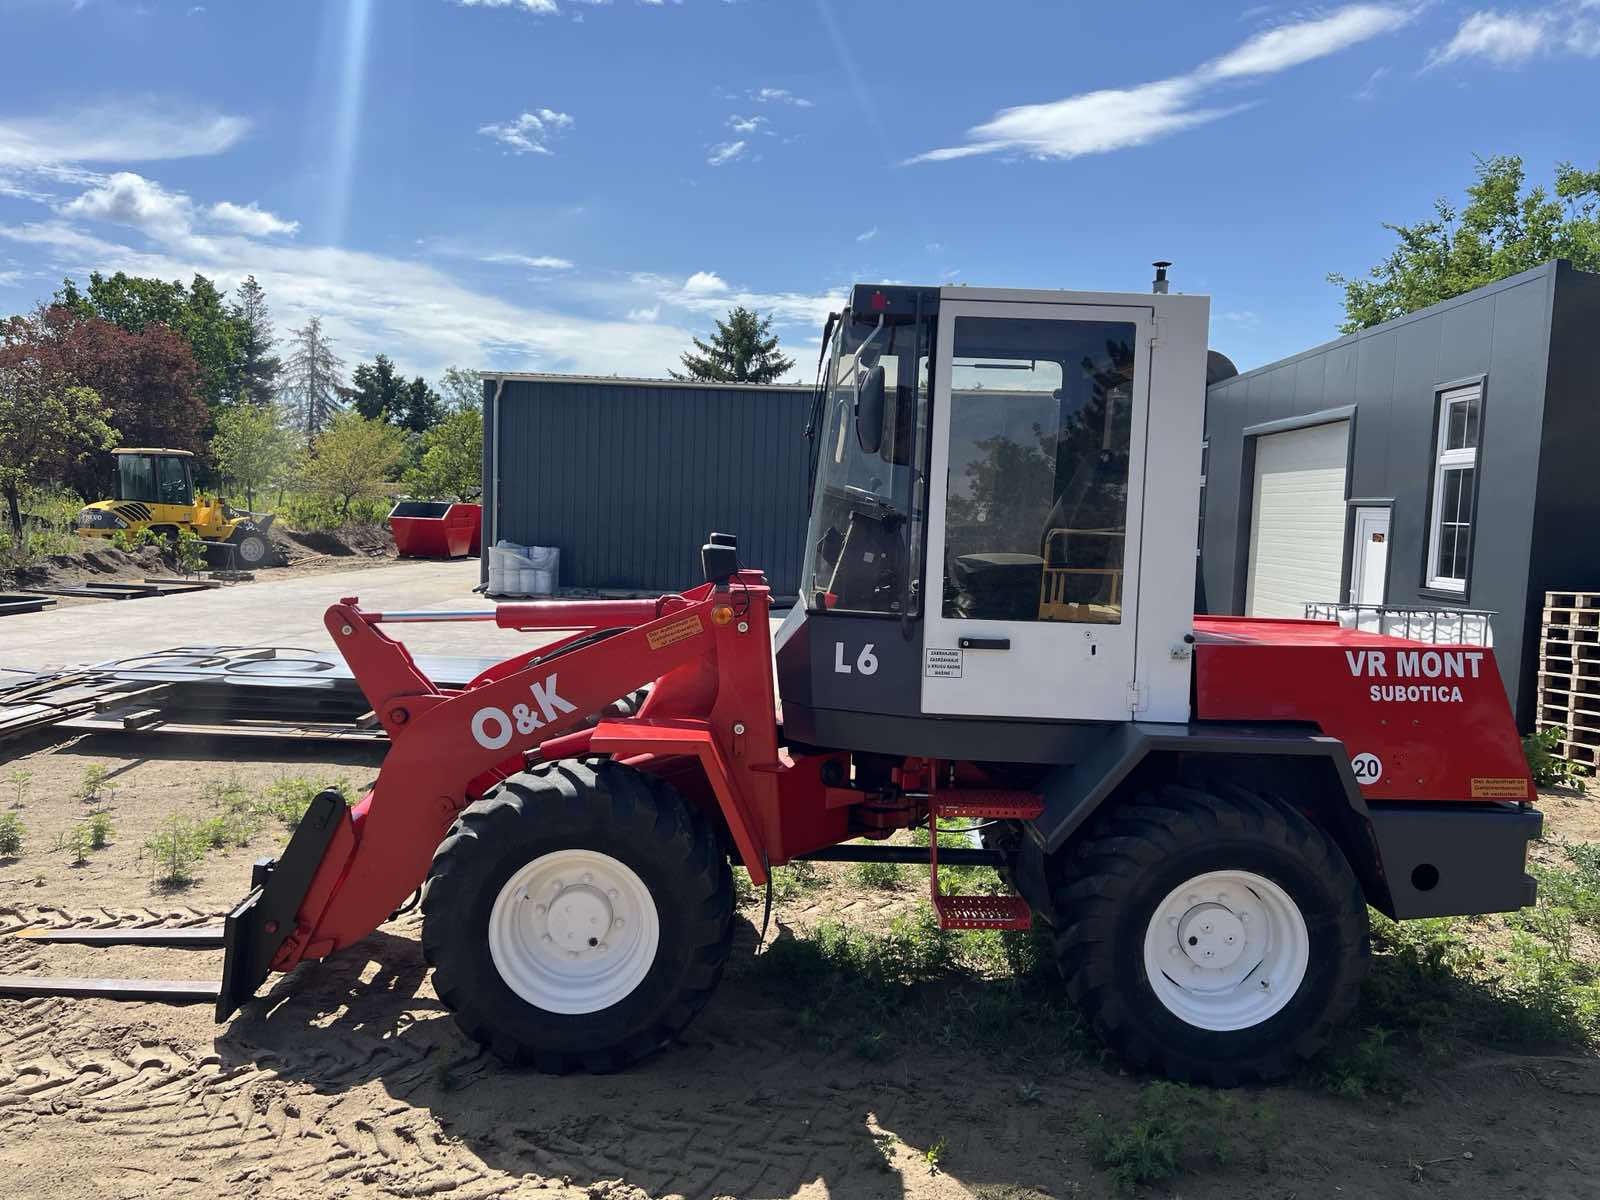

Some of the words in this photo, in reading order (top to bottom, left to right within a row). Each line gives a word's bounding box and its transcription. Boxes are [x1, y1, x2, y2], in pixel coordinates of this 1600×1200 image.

[1345, 650, 1388, 677] VR
[1396, 651, 1484, 678] MONT
[1370, 685, 1463, 702] SUBOTICA
[471, 672, 578, 750] O&K
[1354, 759, 1379, 777] 20
